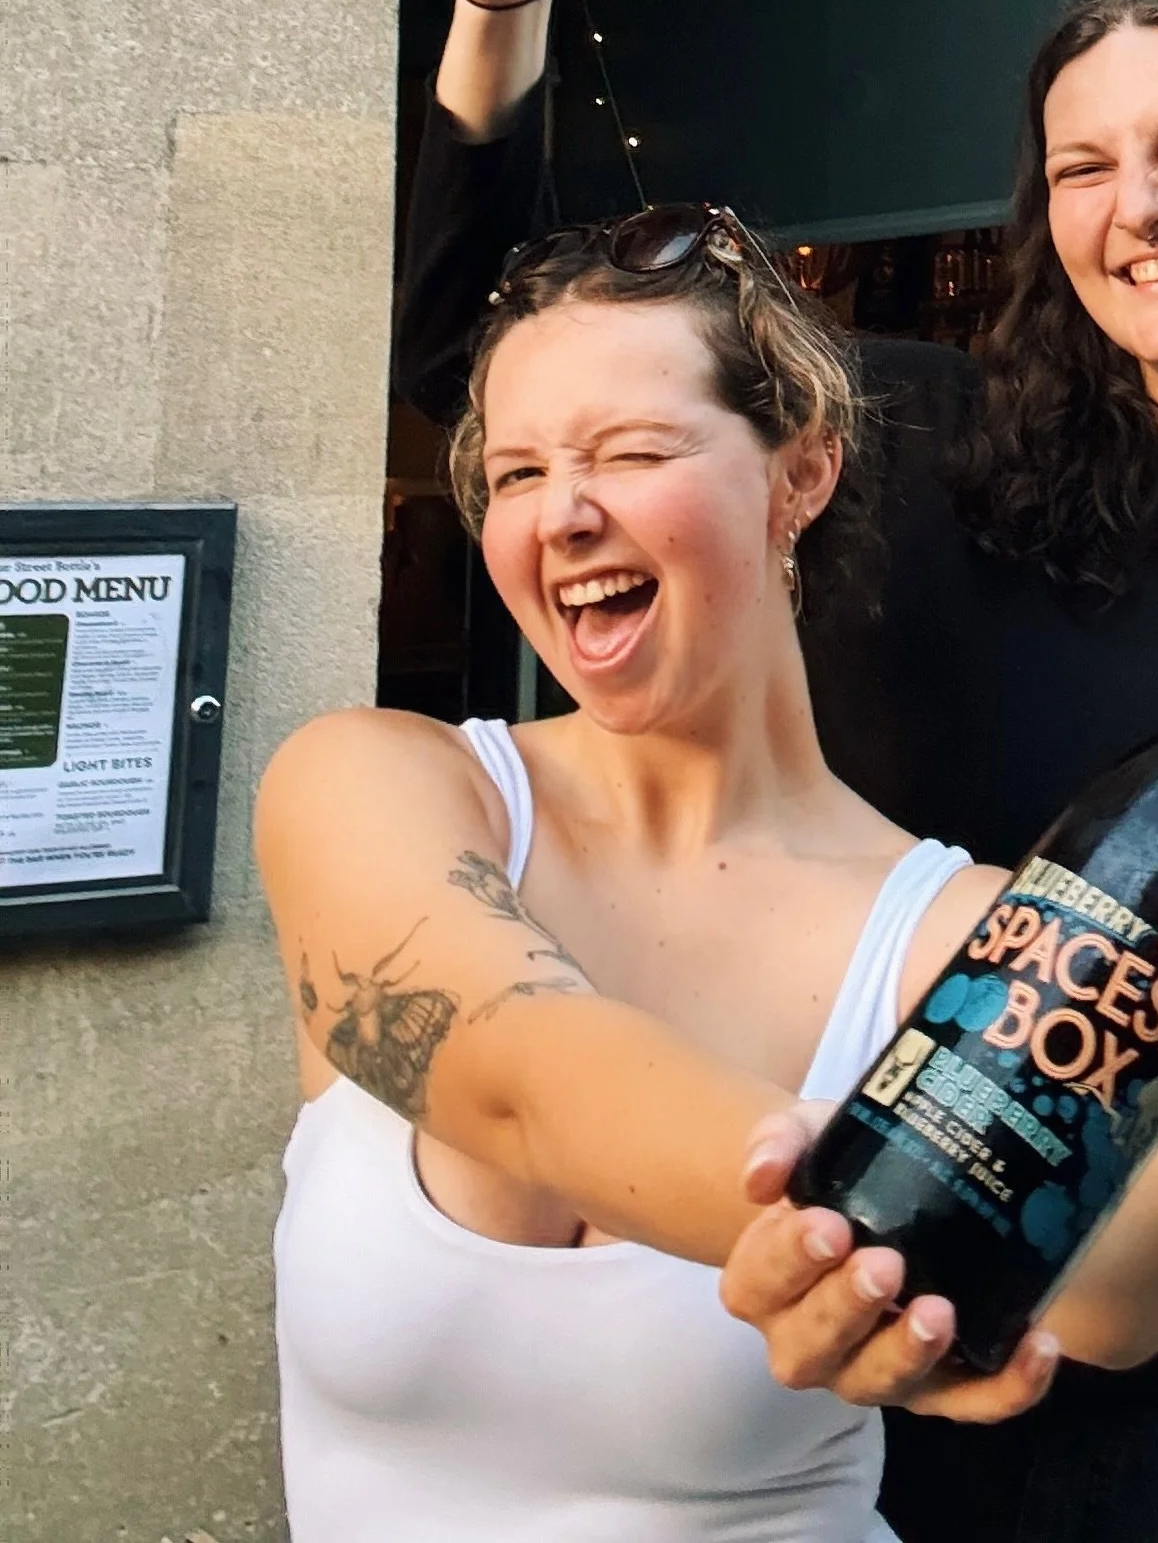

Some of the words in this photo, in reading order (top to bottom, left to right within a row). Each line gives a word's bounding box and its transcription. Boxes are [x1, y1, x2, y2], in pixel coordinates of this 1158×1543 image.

[0, 577, 67, 605] OOD
[71, 575, 172, 603] MENU
[63, 758, 109, 773] LIGHT
[111, 756, 153, 771] BITES
[983, 978, 1140, 1109] BOX
[915, 1067, 994, 1136] CIDER
[928, 1045, 1073, 1168] BLUEBERRY
[946, 1120, 993, 1162] CIDER
[966, 1161, 1015, 1203] JUICE
